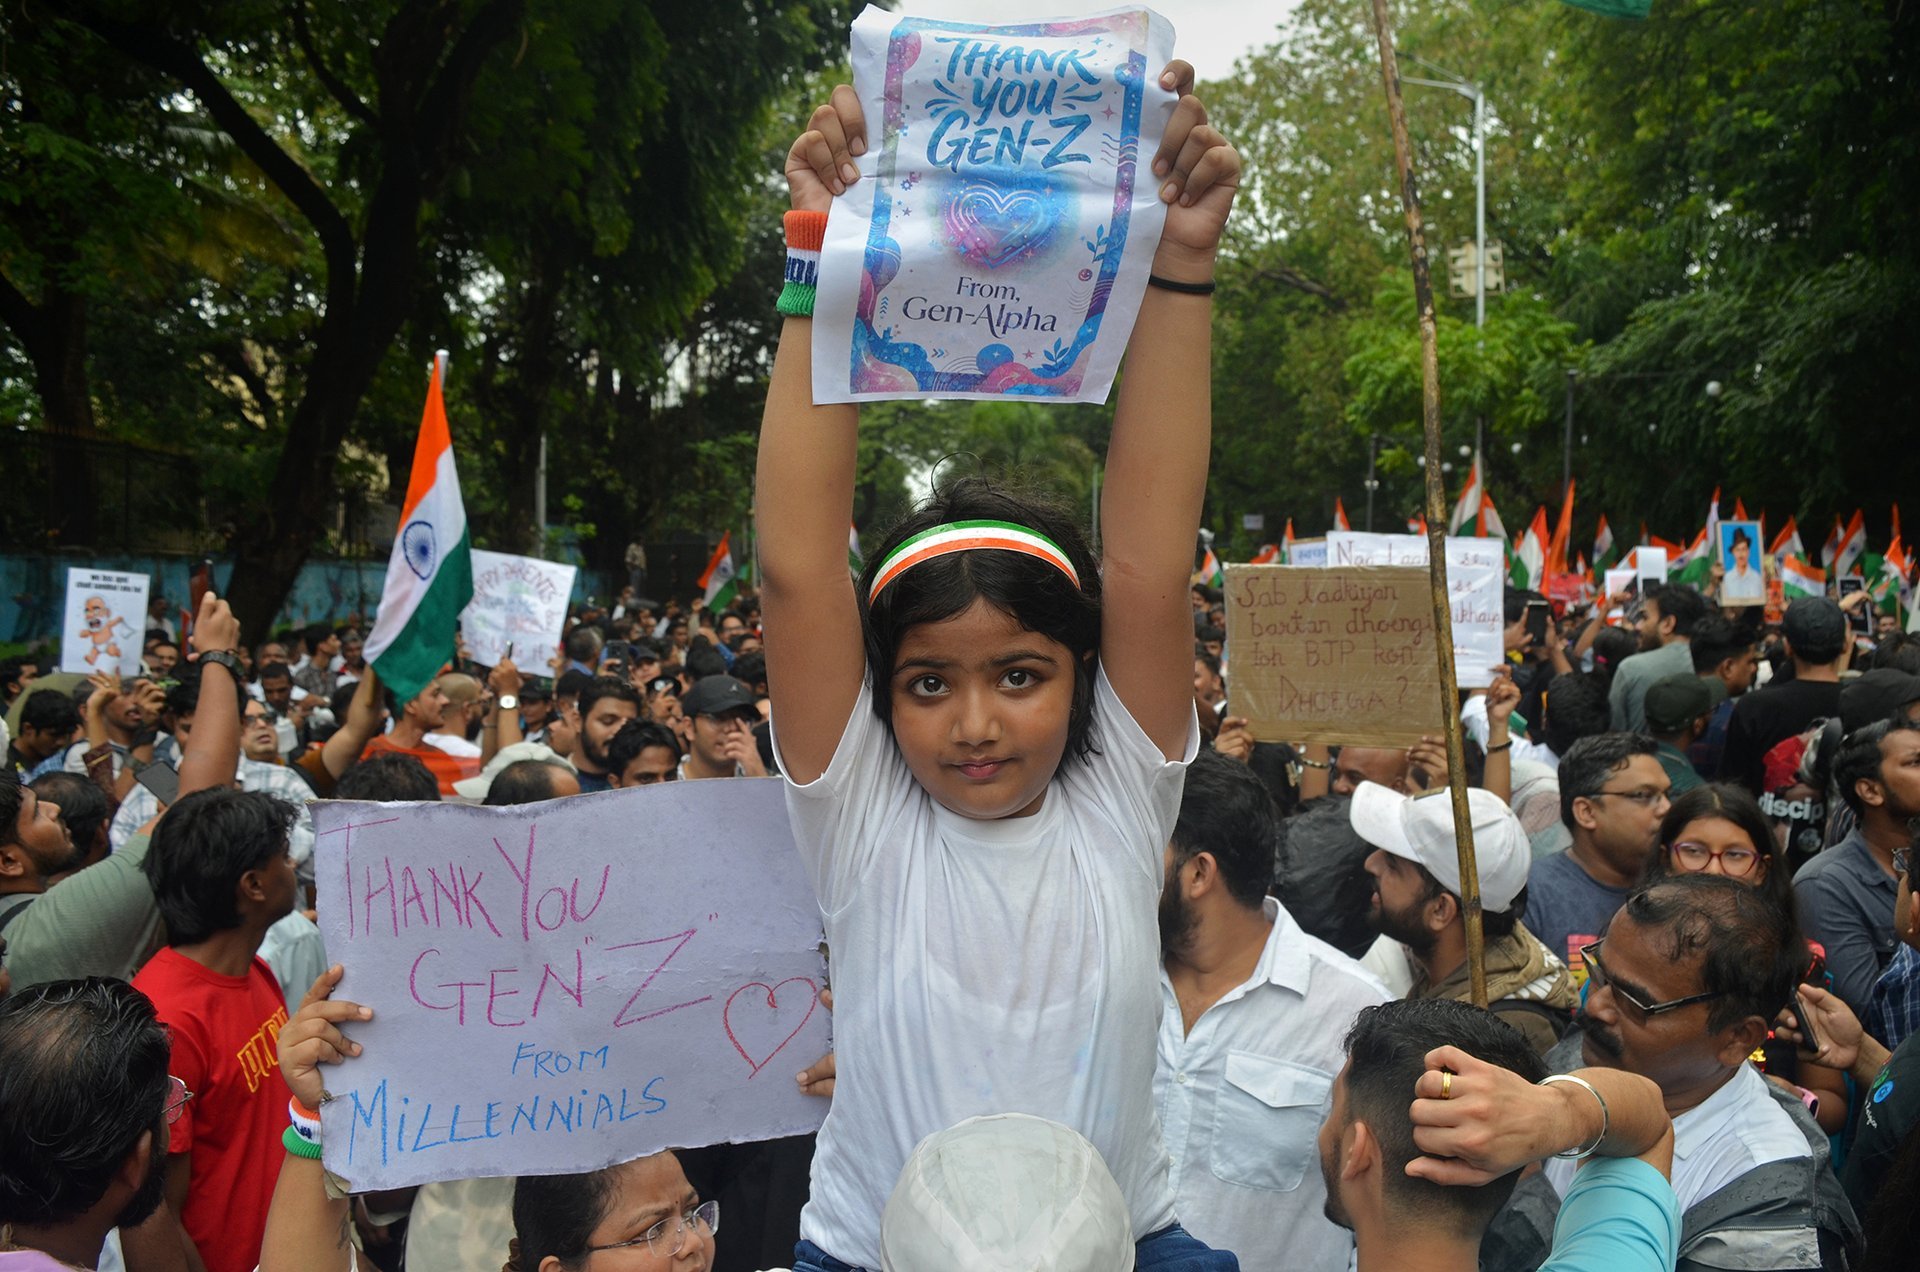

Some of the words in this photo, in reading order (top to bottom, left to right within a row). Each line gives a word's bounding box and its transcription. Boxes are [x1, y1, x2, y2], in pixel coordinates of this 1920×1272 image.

[935, 37, 1102, 85] THANK
[972, 79, 1057, 126] YOU
[926, 112, 1092, 173] GEN-Z
[956, 275, 1020, 302] From,
[902, 296, 1057, 339] Gen-Alpha
[1237, 576, 1287, 608] Sab
[1248, 610, 1330, 637] bartan
[1305, 640, 1356, 667] BJP
[320, 817, 502, 940] THANK
[511, 1041, 609, 1079] FROM
